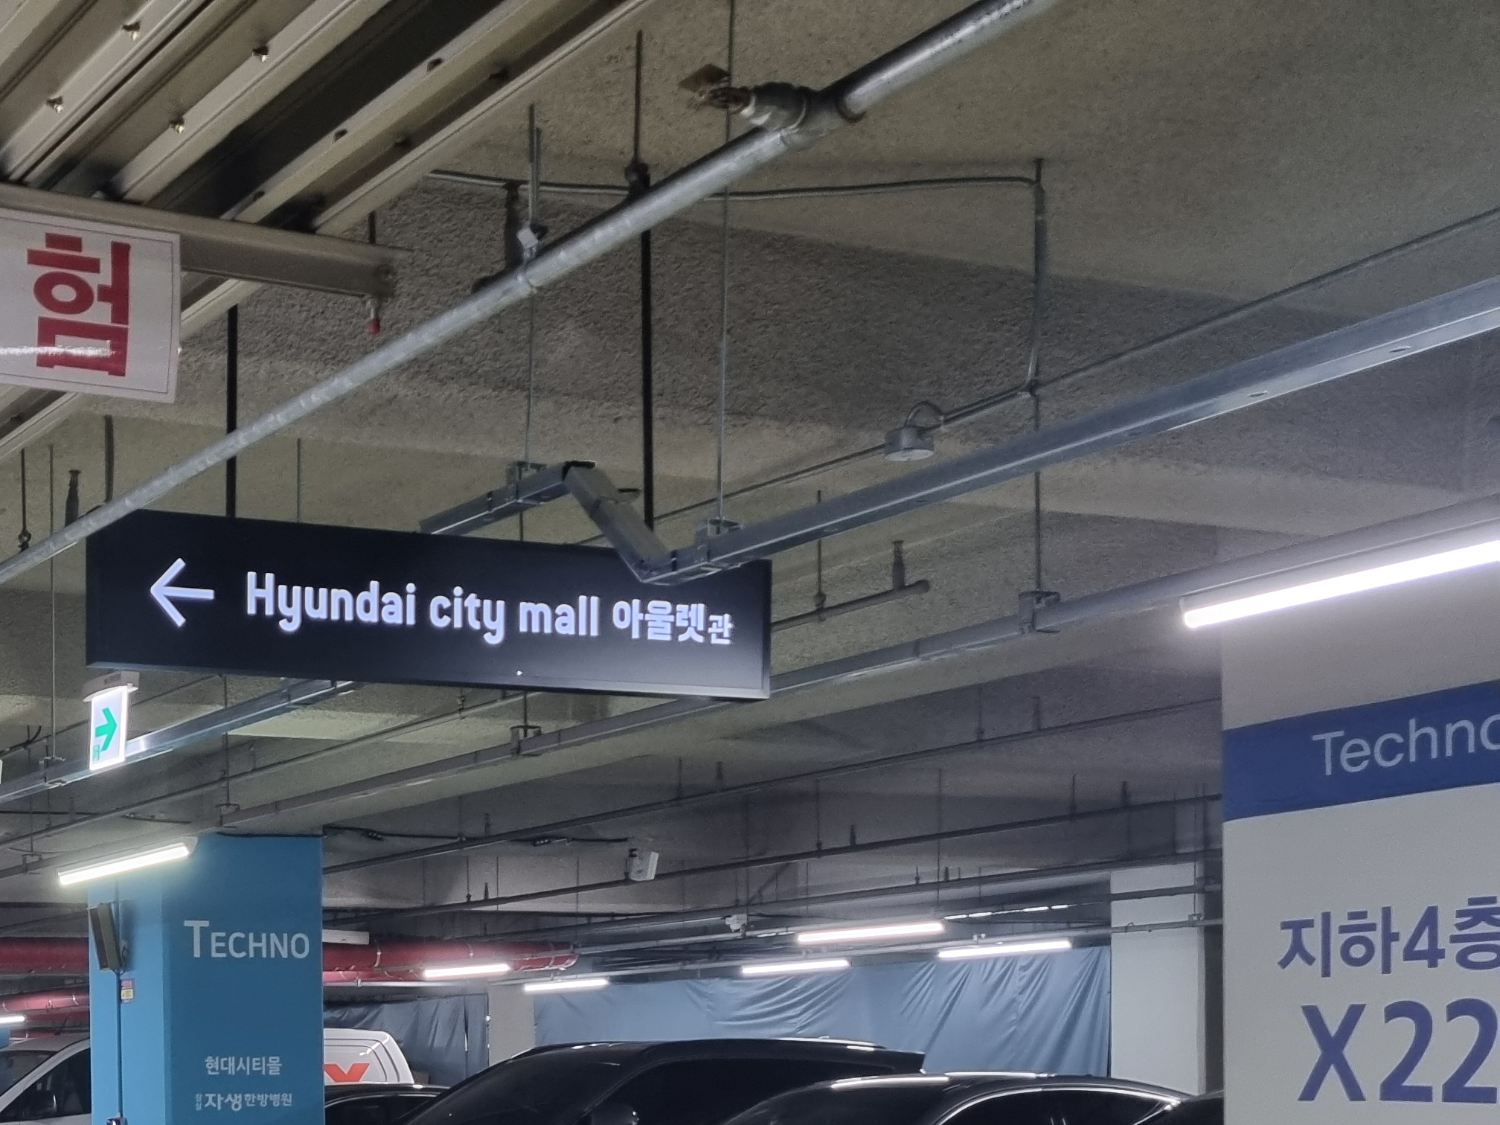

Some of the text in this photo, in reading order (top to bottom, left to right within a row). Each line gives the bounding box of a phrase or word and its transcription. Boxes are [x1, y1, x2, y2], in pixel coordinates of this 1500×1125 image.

[27, 232, 131, 377] 험
[246, 571, 417, 633] Hyundai
[429, 586, 506, 645] city
[519, 595, 600, 637] mall
[1277, 896, 1500, 978] 지하4층
[205, 1056, 282, 1076] 현대시티몰
[1298, 998, 1498, 1104] X22
